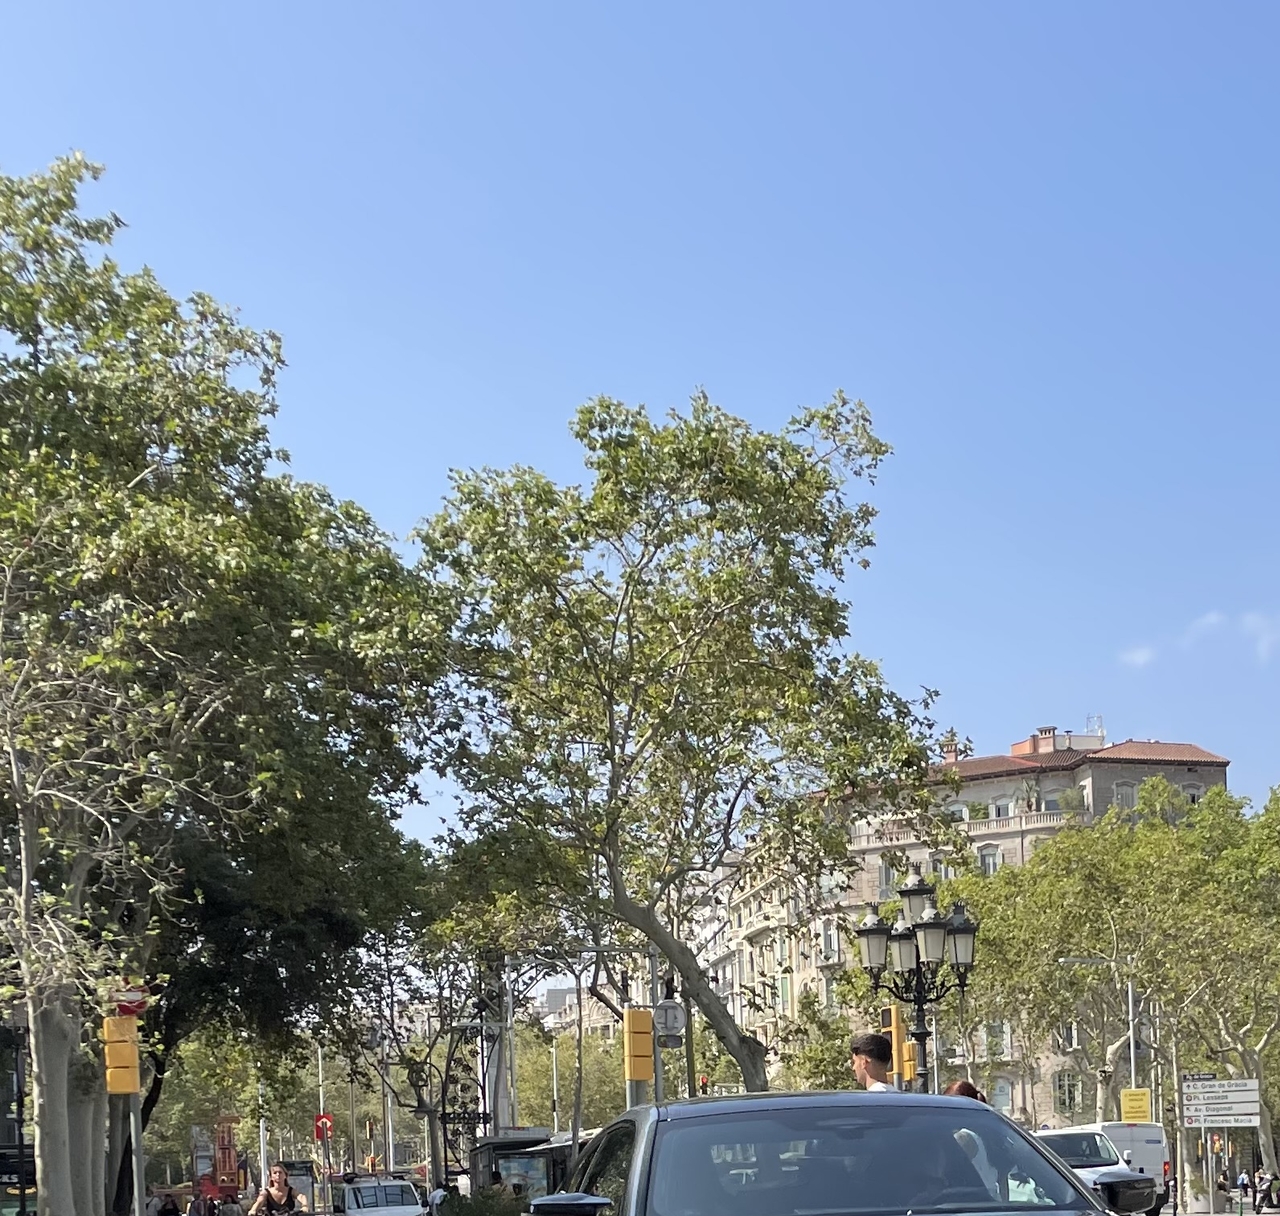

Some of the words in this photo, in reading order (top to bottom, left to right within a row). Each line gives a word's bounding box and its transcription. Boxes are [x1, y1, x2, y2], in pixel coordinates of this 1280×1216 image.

[1205, 1105, 1233, 1113] Diagonal
[1203, 1117, 1232, 1125] Francesc
[0, 1174, 19, 1183] KS
